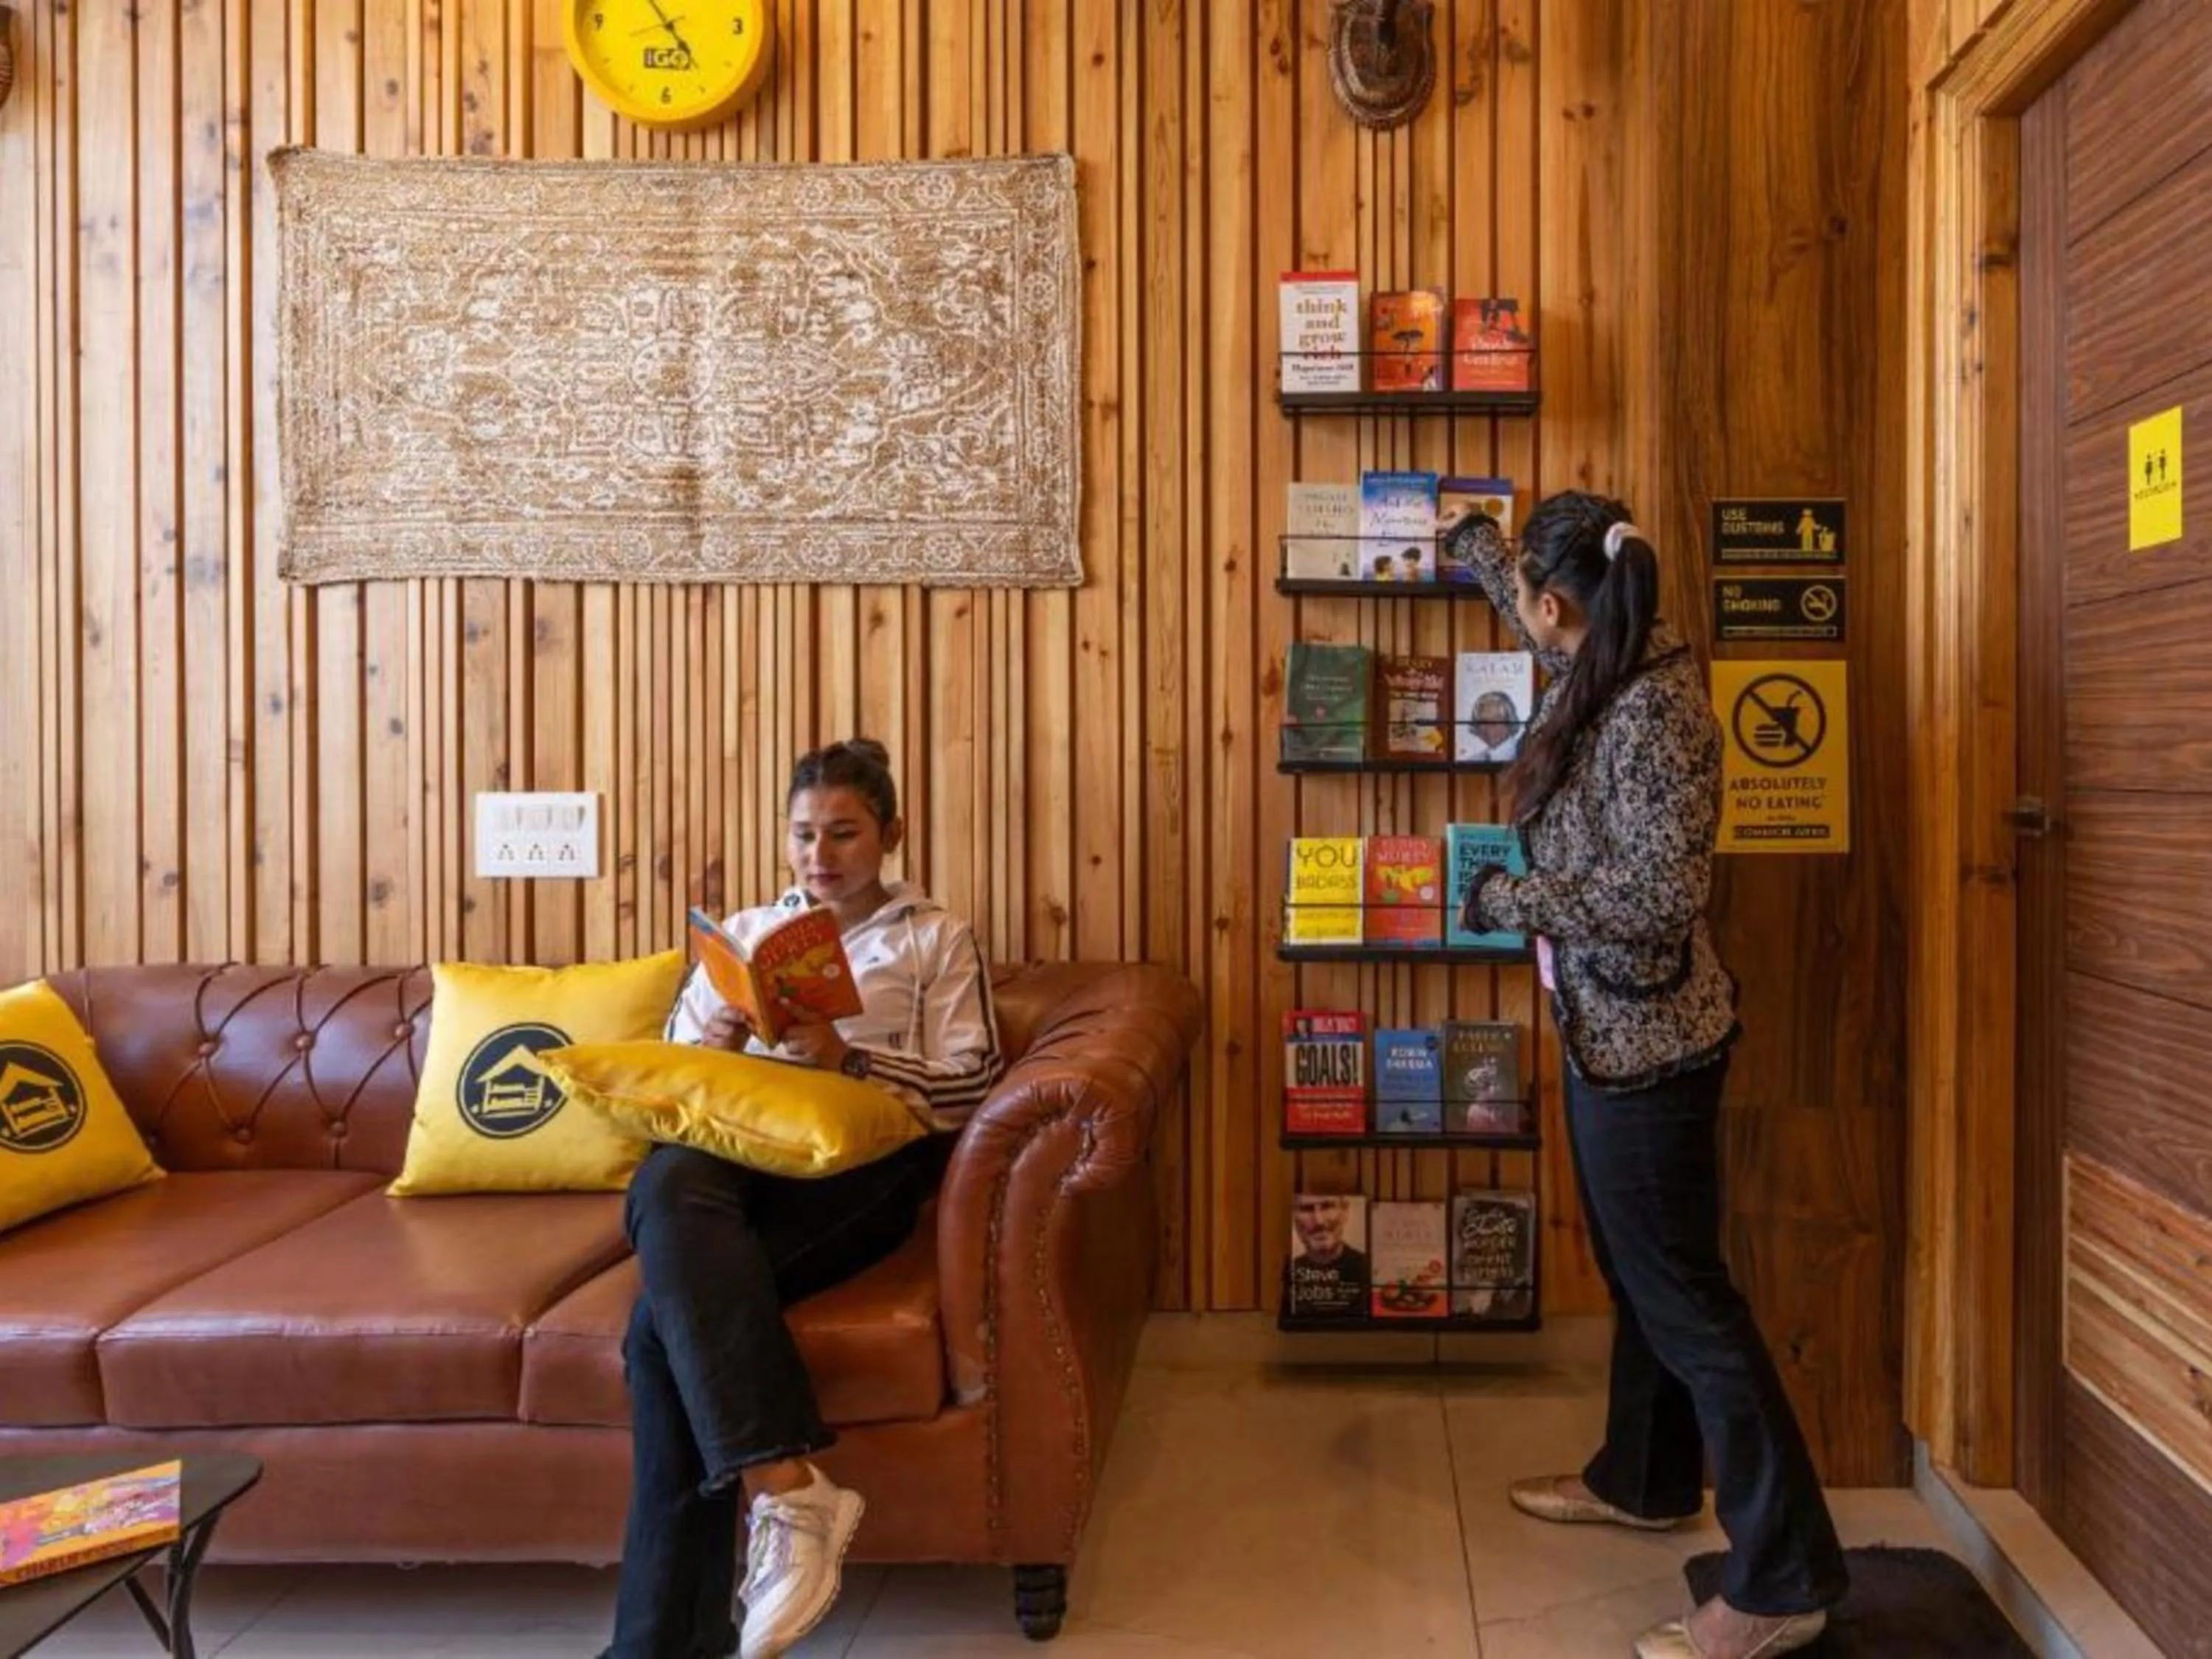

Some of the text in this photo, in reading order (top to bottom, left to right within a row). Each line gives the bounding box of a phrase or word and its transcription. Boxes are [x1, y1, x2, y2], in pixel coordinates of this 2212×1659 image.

[594, 13, 603, 30] 9
[732, 18, 743, 35] 3
[661, 86, 672, 104] 6
[1296, 298, 1347, 314] think
[1305, 316, 1340, 329] and
[1722, 508, 1747, 520] USE
[1729, 777, 1826, 790] ABSOLUTELY
[1736, 796, 1822, 810] NO EATING
[1296, 844, 1357, 868] YOU
[1459, 844, 1511, 856] EVERY
[1295, 1043, 1359, 1086] GOALS!
[1296, 1267, 1339, 1282] Steve
[1295, 1284, 1335, 1303] Jobs
